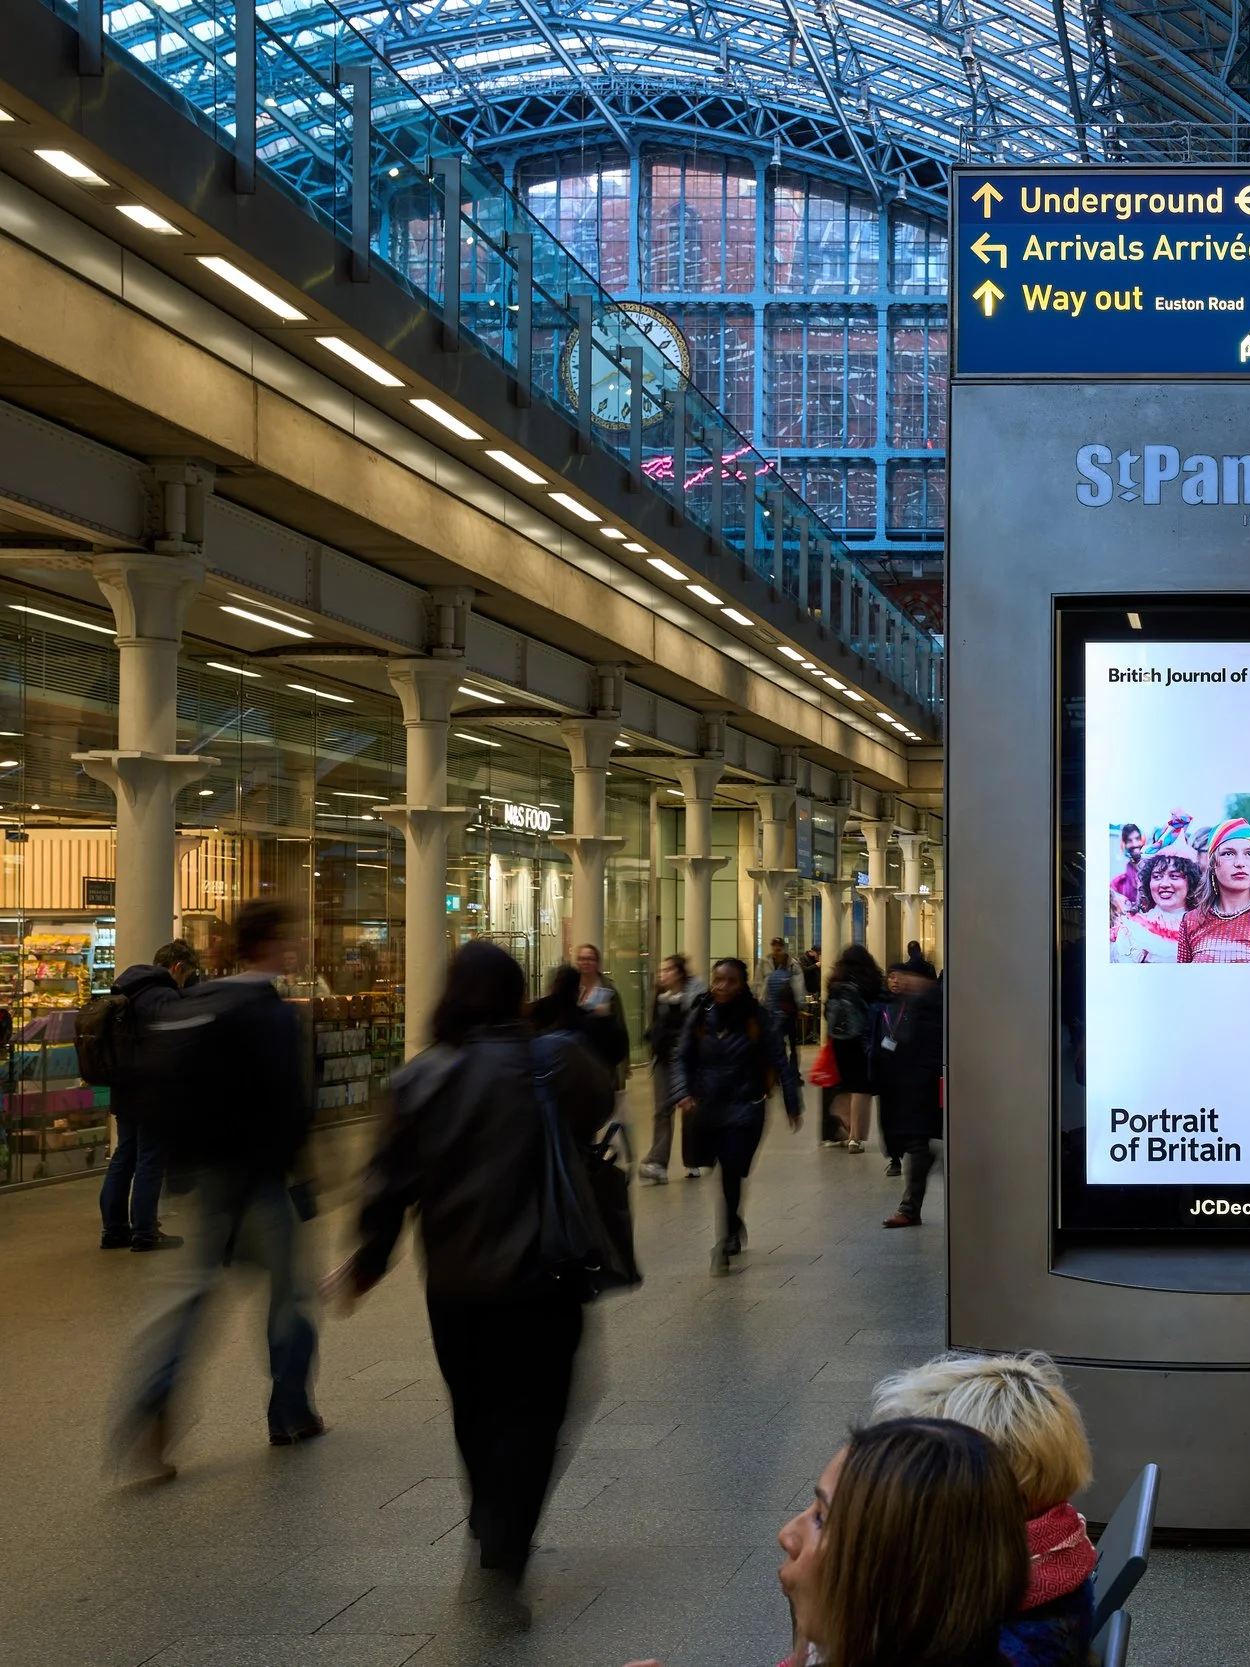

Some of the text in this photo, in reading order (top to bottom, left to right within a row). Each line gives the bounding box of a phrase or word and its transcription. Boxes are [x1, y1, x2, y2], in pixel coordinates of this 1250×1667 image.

[1021, 187, 1223, 220] Underground
[1022, 234, 1144, 261] Arrivals
[1022, 284, 1144, 318] Way out
[1155, 297, 1245, 311] Euston Road
[1108, 667, 1162, 683] British
[1165, 667, 1226, 687] Journal
[1230, 667, 1249, 683] of
[504, 803, 551, 831] M&S FOOD
[1110, 1107, 1219, 1133] Portrait
[1110, 1136, 1241, 1162] of Britain
